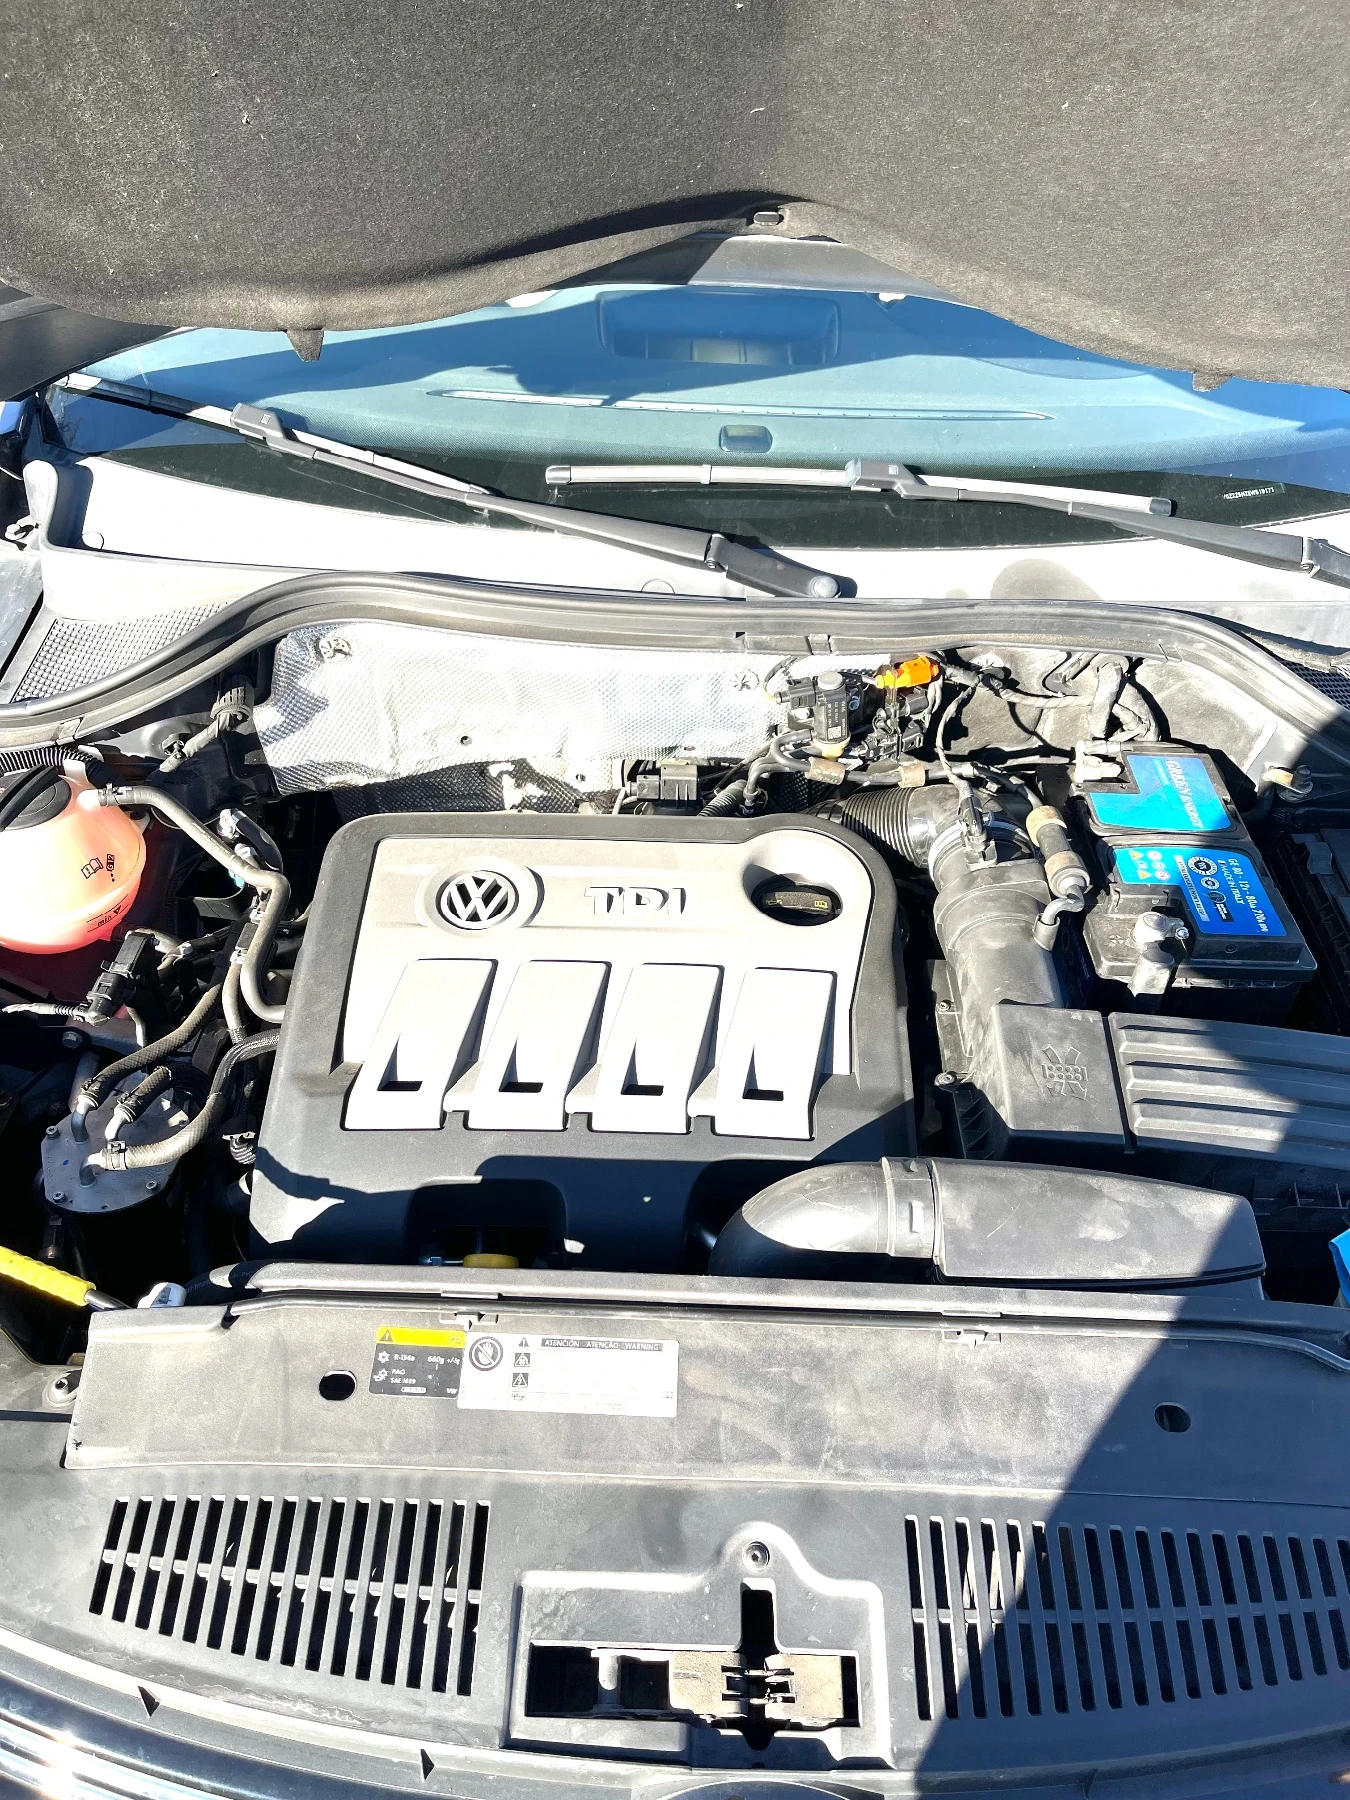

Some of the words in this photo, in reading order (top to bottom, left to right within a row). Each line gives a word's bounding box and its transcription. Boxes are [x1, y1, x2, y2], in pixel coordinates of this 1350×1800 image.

[1166, 760, 1193, 797] GREEN
[1221, 866, 1235, 882] MADE
[1231, 888, 1245, 905] ITALY
[584, 887, 686, 914] TDI
[98, 915, 112, 927] min
[544, 1339, 580, 1348] ATENCIÓN
[586, 1340, 619, 1350] ATENÇÃO
[625, 1342, 659, 1351] WARNING
